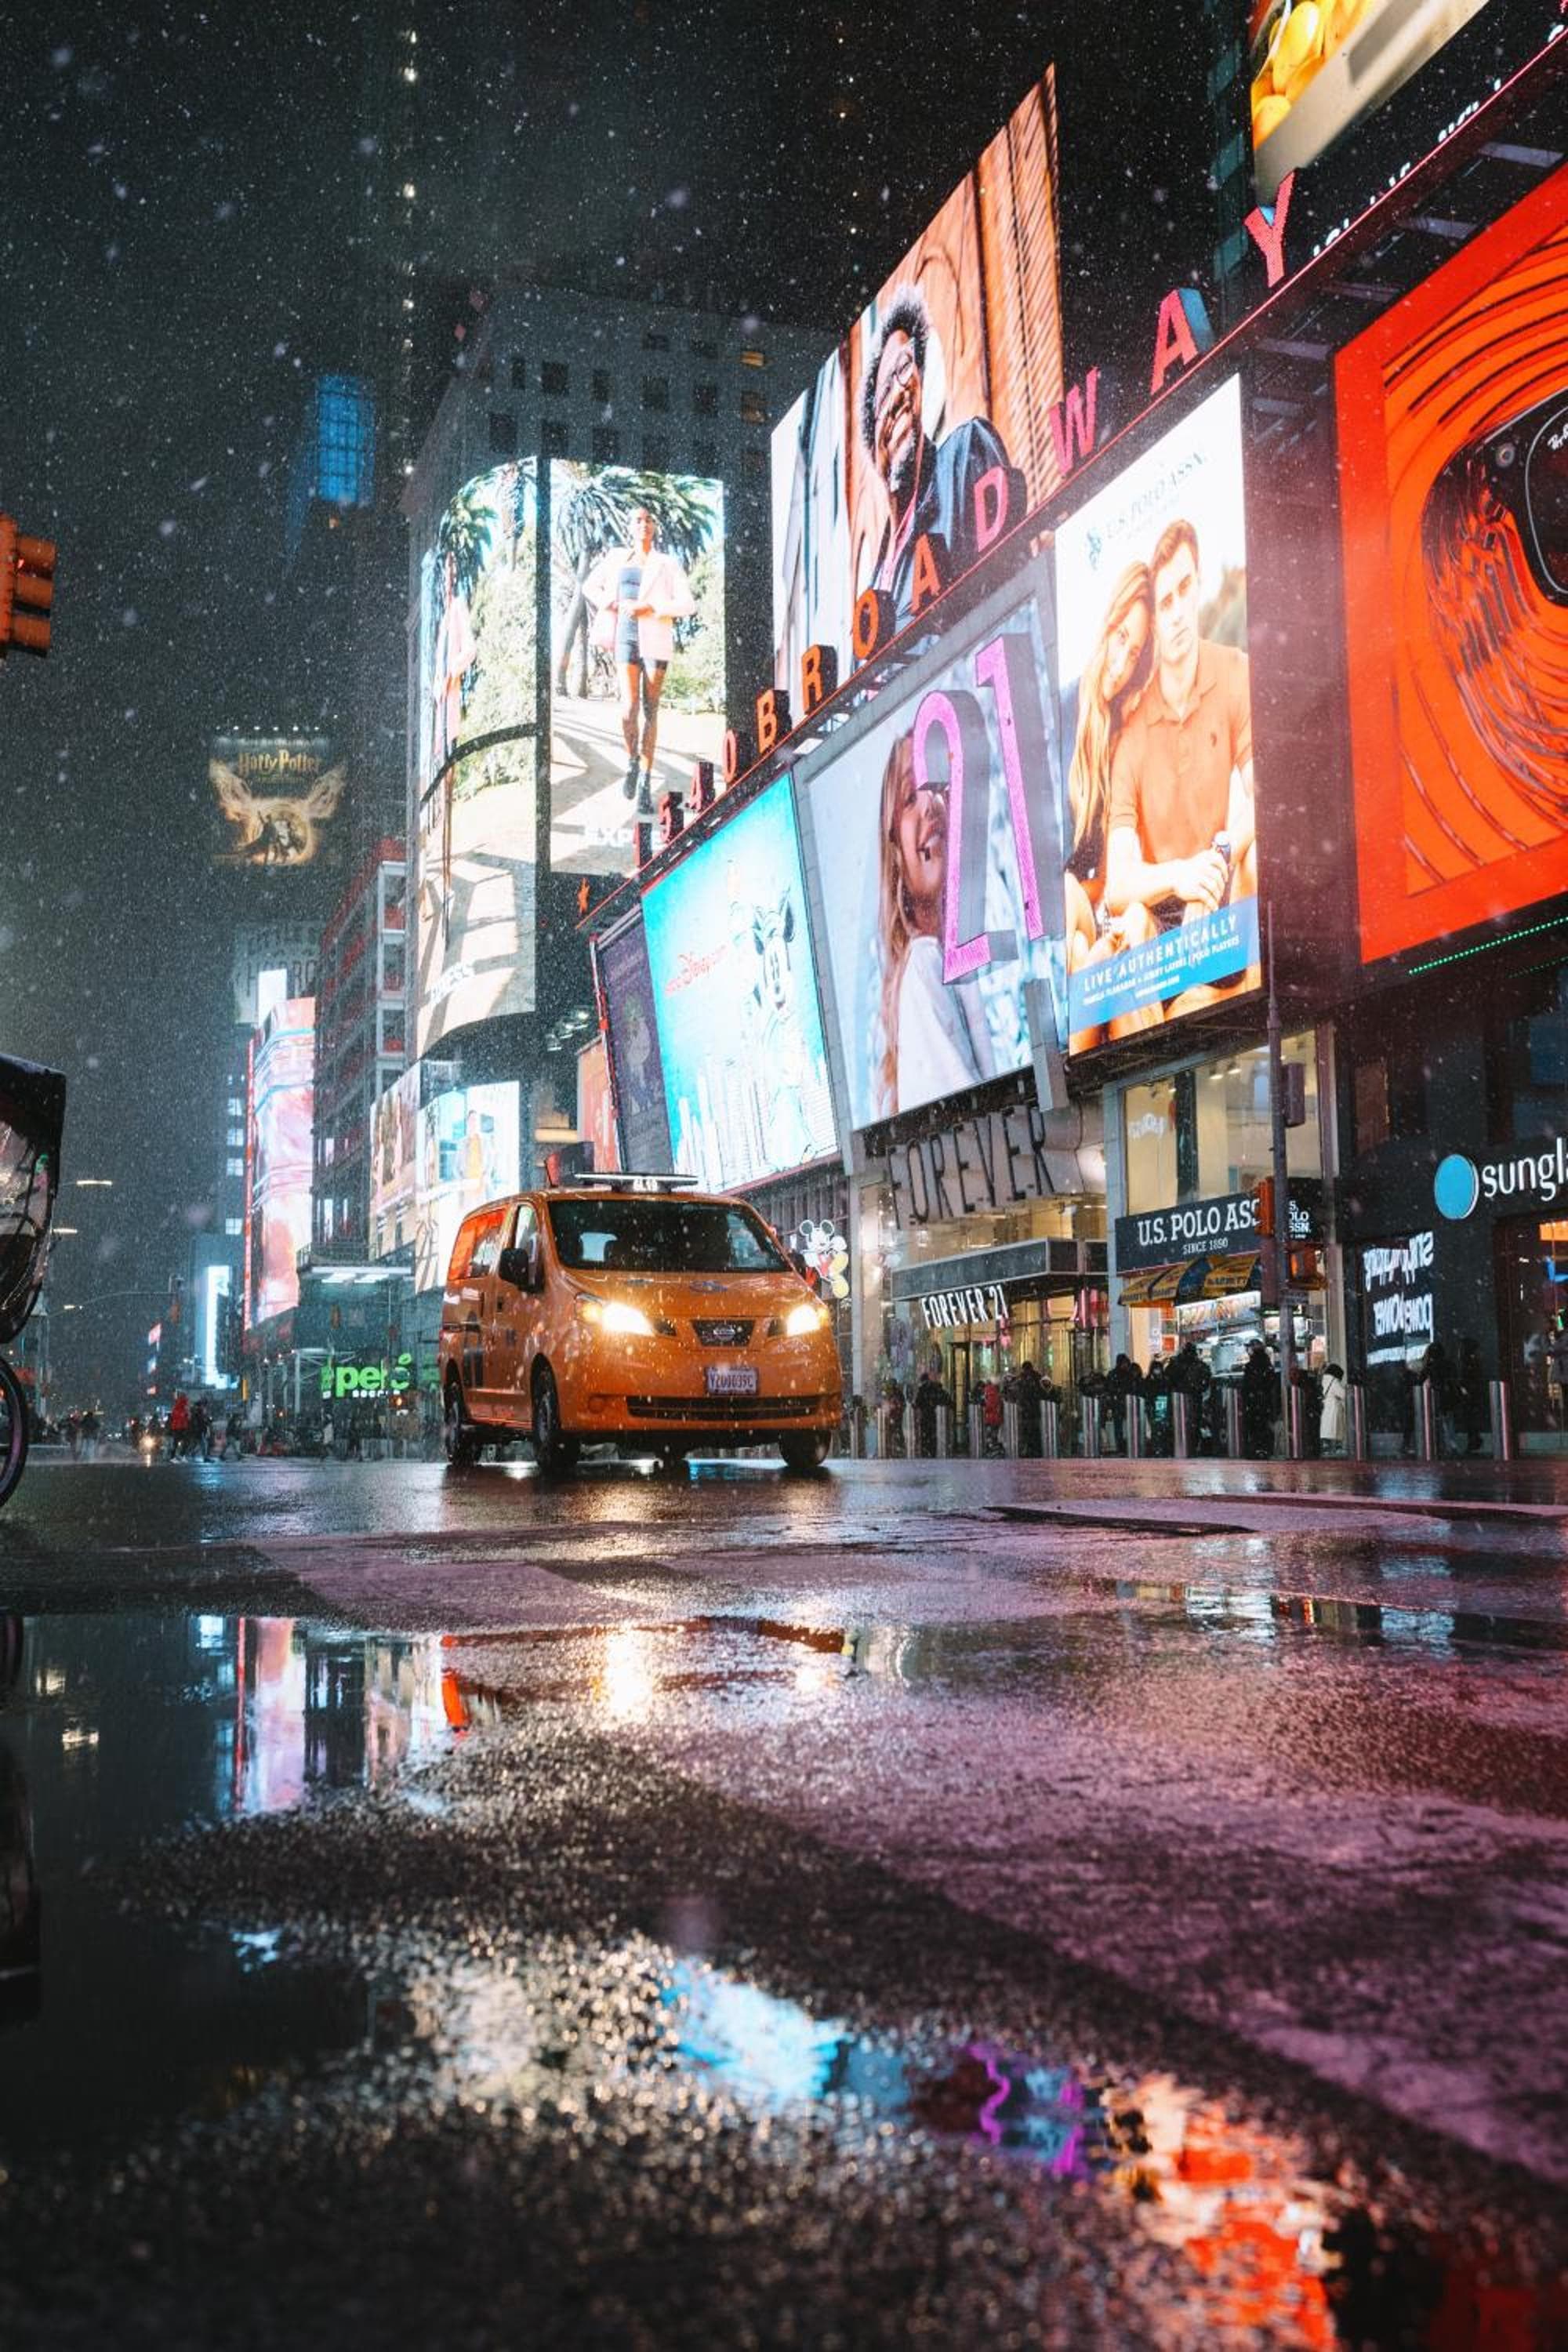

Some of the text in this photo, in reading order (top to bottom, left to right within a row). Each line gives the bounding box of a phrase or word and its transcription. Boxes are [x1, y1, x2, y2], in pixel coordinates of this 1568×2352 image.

[757, 169, 1296, 753] BROADWAY
[238, 749, 321, 778] Harry Potter
[913, 635, 1045, 985] 21
[1083, 965, 1113, 992] LIVE
[1118, 914, 1238, 978] AUTHENTICALLY
[886, 1102, 1055, 1230] FOREVER
[1481, 1137, 1568, 1202] sungl
[1138, 1218, 1168, 1247] U.S.
[1171, 1206, 1221, 1241] POLO
[1182, 1236, 1229, 1254] SINCE 1890
[920, 1283, 1010, 1330] FOREVER 21
